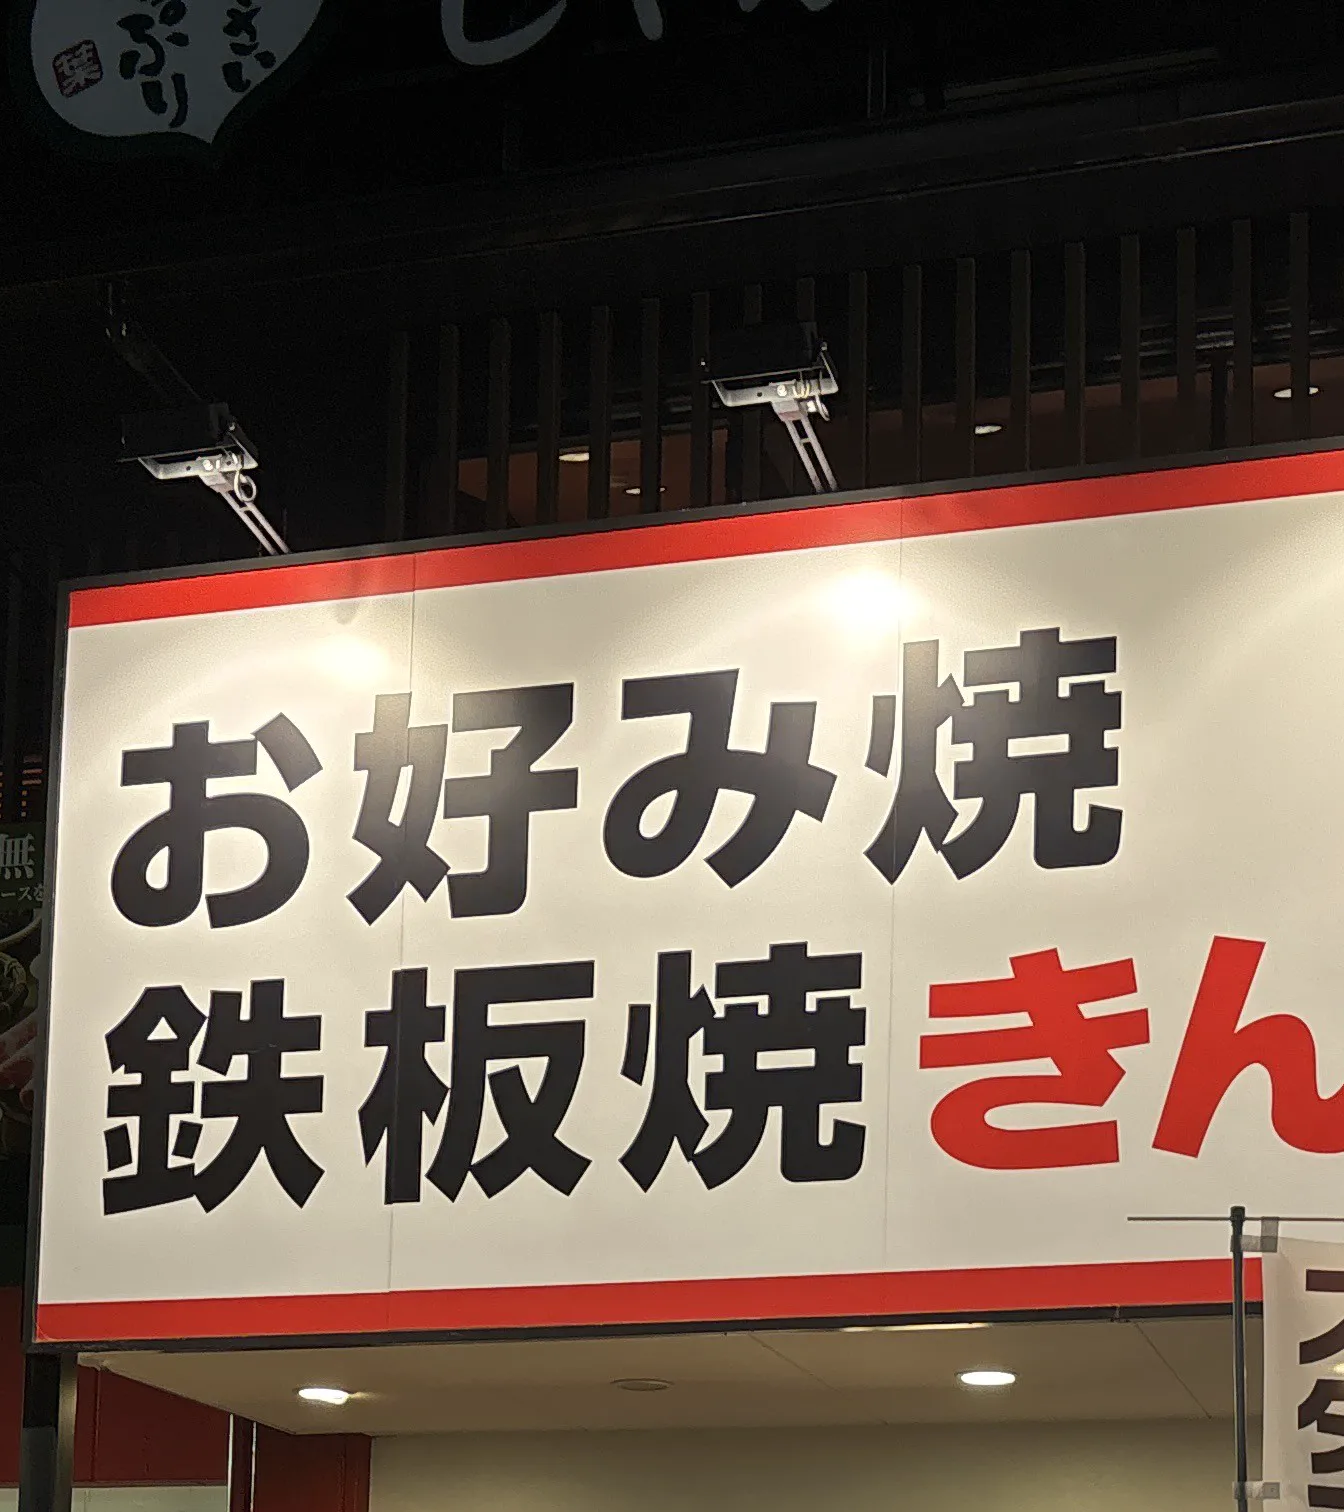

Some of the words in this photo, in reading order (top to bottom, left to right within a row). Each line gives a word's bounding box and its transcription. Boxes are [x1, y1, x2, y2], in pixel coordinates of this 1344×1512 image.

[110, 626, 1122, 928] お好み焼
[102, 941, 866, 1215] 鉄板焼
